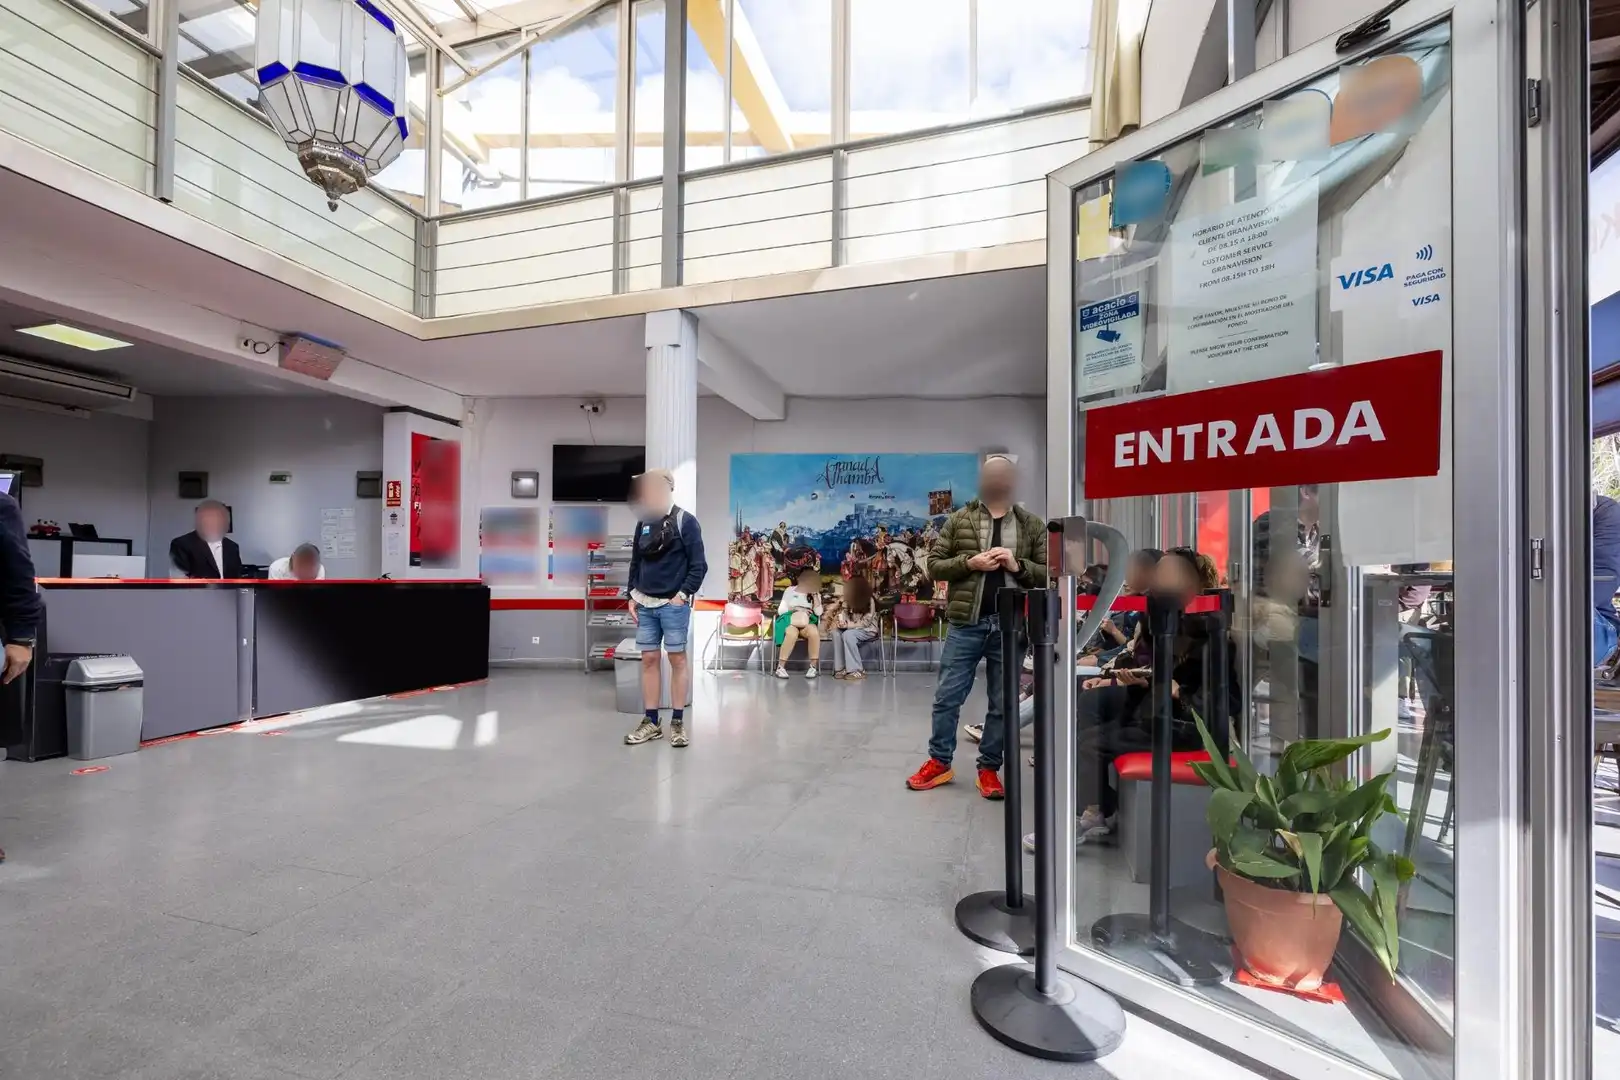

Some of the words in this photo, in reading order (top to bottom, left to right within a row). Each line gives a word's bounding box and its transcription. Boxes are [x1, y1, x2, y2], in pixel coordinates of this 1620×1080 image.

[1192, 223, 1224, 238] HORARIO
[1226, 219, 1234, 227] DE
[1198, 232, 1226, 246] CLIENTE
[1202, 250, 1242, 266] CUSTOMER
[1243, 240, 1274, 254] SERVICE
[1200, 278, 1220, 288] FROM
[1248, 267, 1258, 276] TO
[1260, 264, 1276, 272] 18H
[1336, 262, 1394, 290] VISA
[1403, 272, 1446, 288] SEGURIDAD
[1406, 272, 1426, 280] PAGA
[1427, 267, 1444, 276] CON
[1092, 298, 1126, 314] acacio
[1412, 293, 1440, 306] VISA
[1100, 310, 1118, 320] ZONA
[1224, 303, 1250, 314] MUESTRE
[1244, 304, 1282, 316] MOSTRADOR
[1082, 310, 1136, 330] VIDEOVIGILADA
[1228, 320, 1248, 328] FONDO
[1190, 347, 1208, 355] PLEASE
[1209, 343, 1226, 351] SHOW
[1227, 340, 1243, 348] YOUR
[1244, 330, 1289, 344] CONFIRMATION
[1208, 350, 1233, 358] VOUCHER
[1114, 400, 1386, 468] ENTRADA
